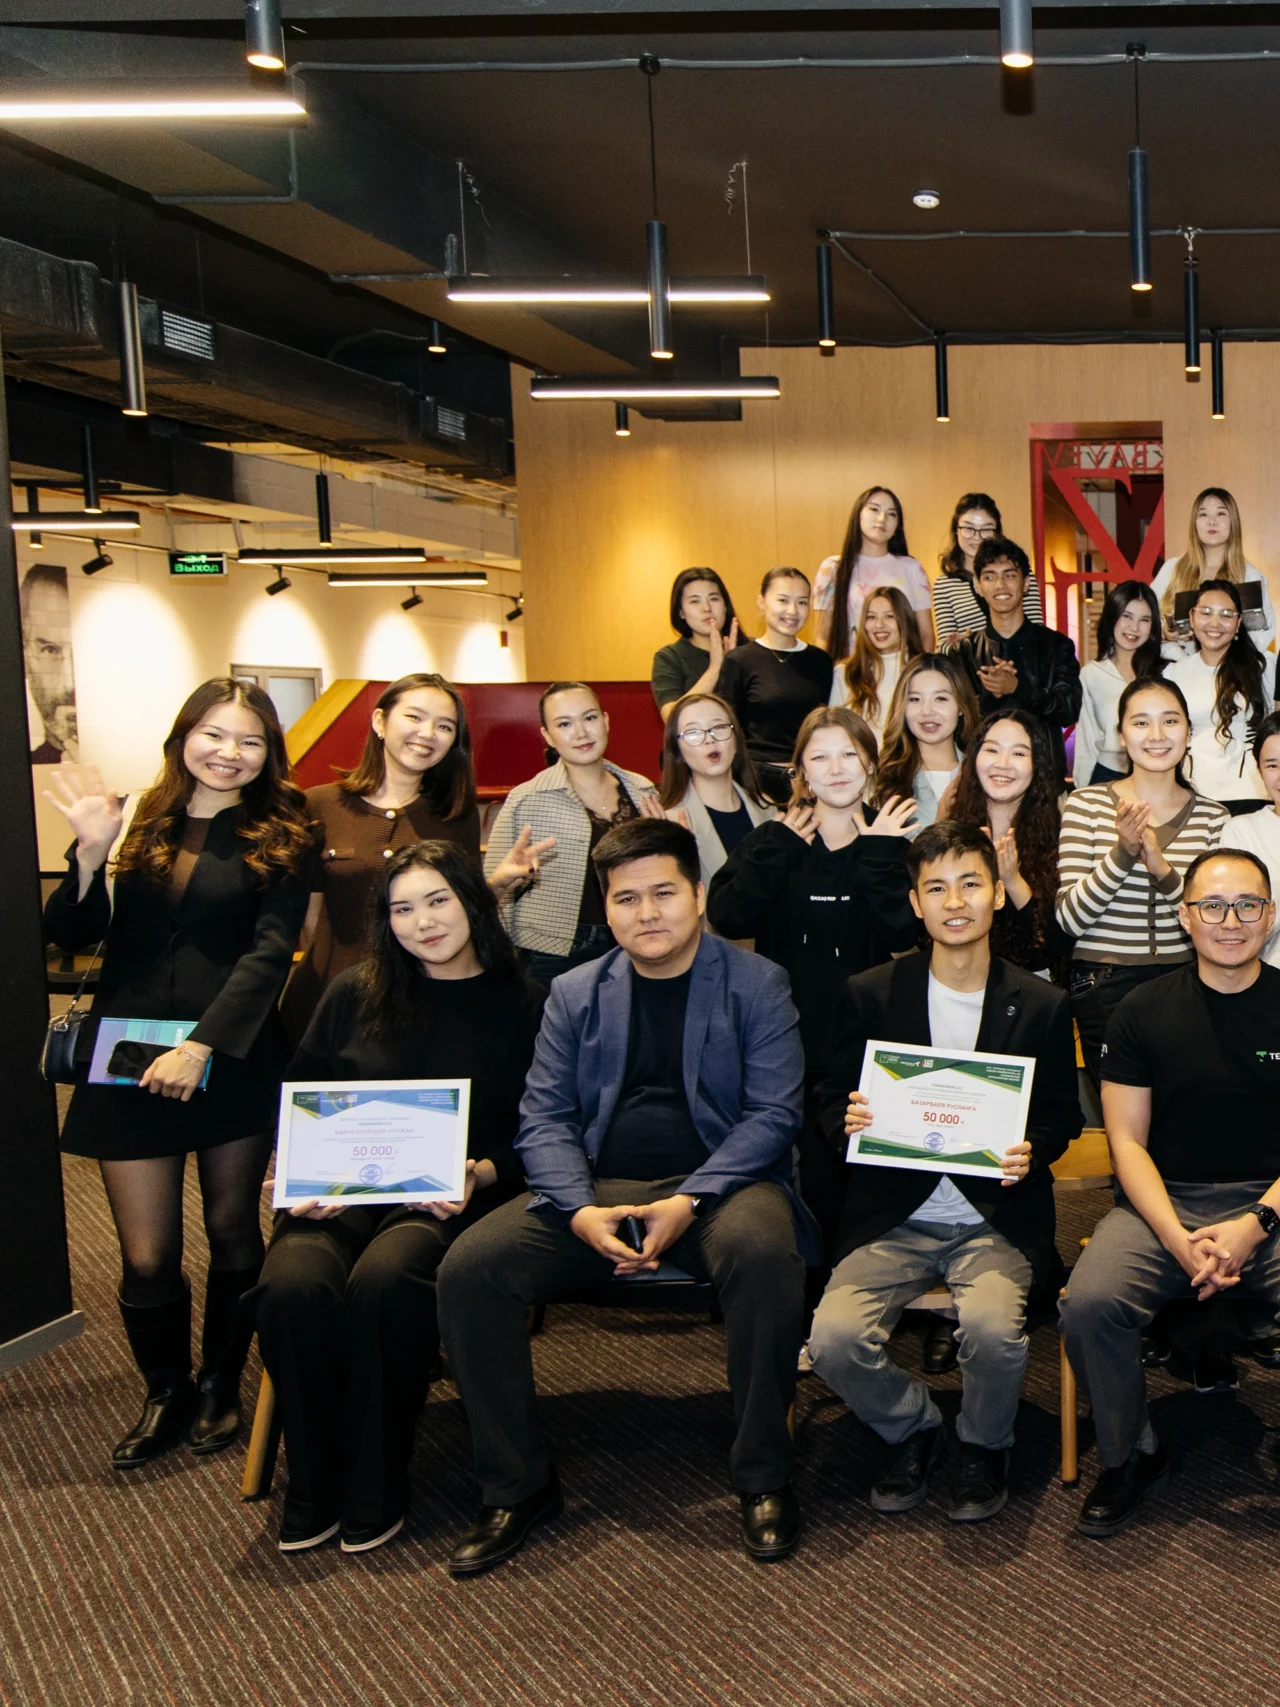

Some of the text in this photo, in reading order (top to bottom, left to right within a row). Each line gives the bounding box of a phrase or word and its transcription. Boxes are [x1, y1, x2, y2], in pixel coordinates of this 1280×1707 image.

[922, 1111, 937, 1123] 50
[939, 1113, 960, 1125] 000
[352, 1145, 393, 1156] 50 000
